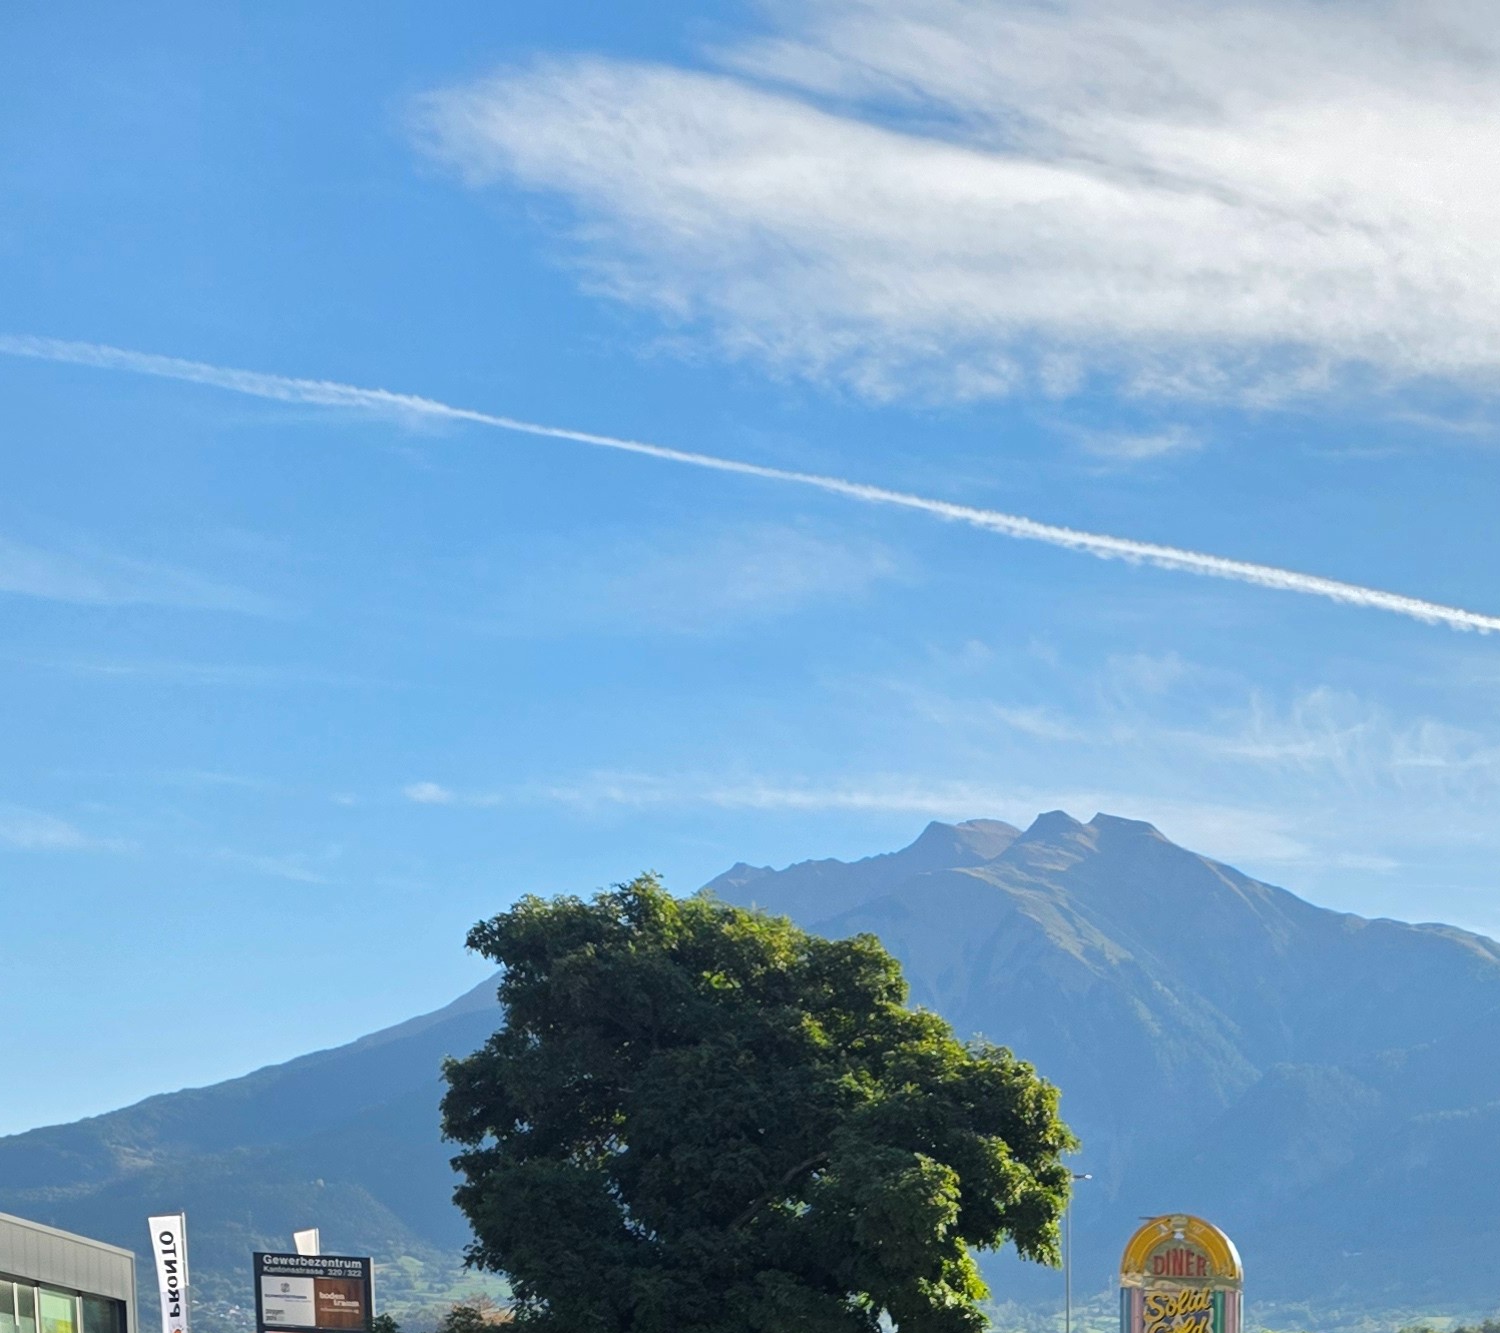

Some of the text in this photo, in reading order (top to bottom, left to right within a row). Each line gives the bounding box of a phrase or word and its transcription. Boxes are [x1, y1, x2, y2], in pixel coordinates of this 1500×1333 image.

[263, 1254, 363, 1269] Gewerbezentrum
[263, 1265, 324, 1276] Kantonsstrasse
[1153, 1248, 1207, 1277] DINER
[1144, 1287, 1212, 1323] Solid
